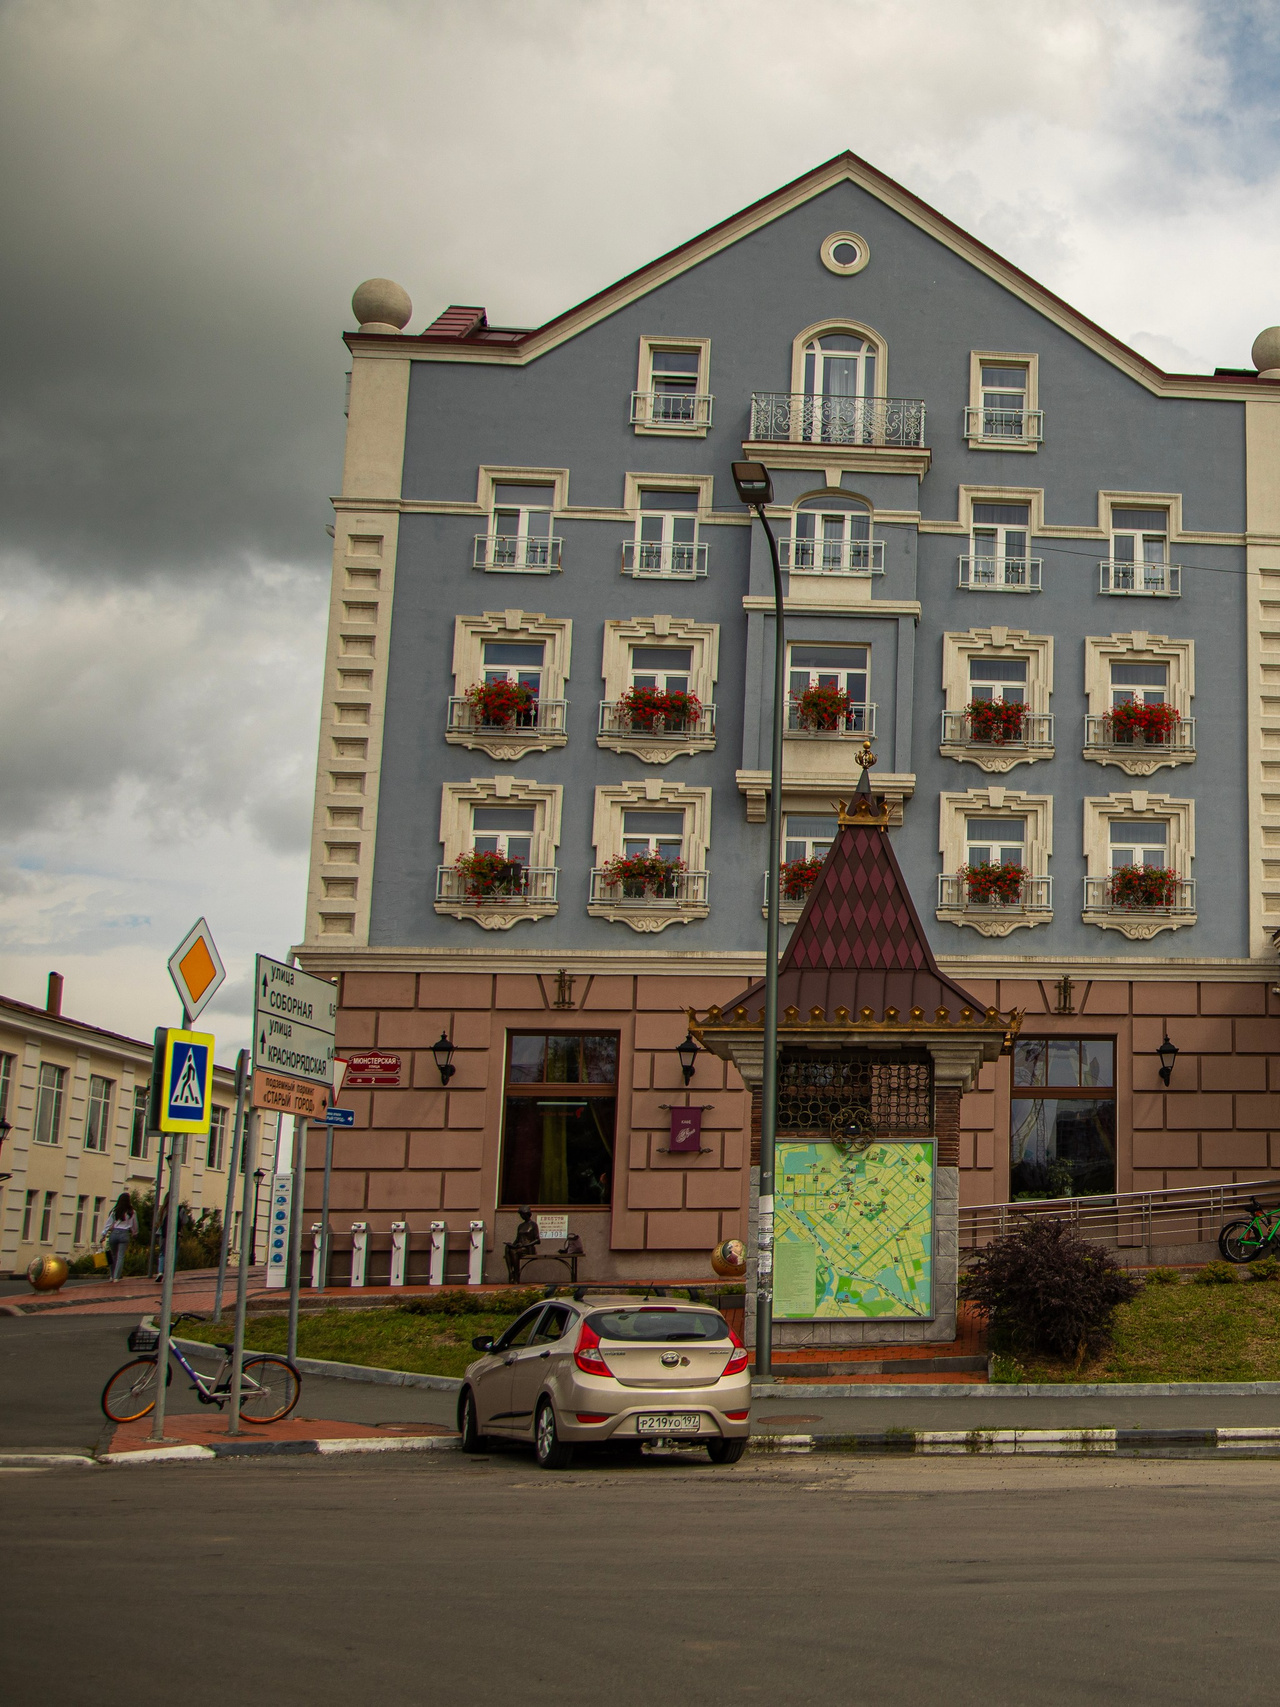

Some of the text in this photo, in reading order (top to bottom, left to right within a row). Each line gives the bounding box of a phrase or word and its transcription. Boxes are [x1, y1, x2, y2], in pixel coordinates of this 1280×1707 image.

[271, 966, 295, 987] улица
[270, 990, 313, 1020] СОБОРНАЯ
[269, 1019, 292, 1039] улица
[268, 1045, 327, 1076] КРАСНОРЯДСКАЯ
[353, 1057, 397, 1065] МЮНСТЕРСКАЯ
[265, 1077, 315, 1096] подземный паркинг
[683, 1416, 697, 1425] 197
